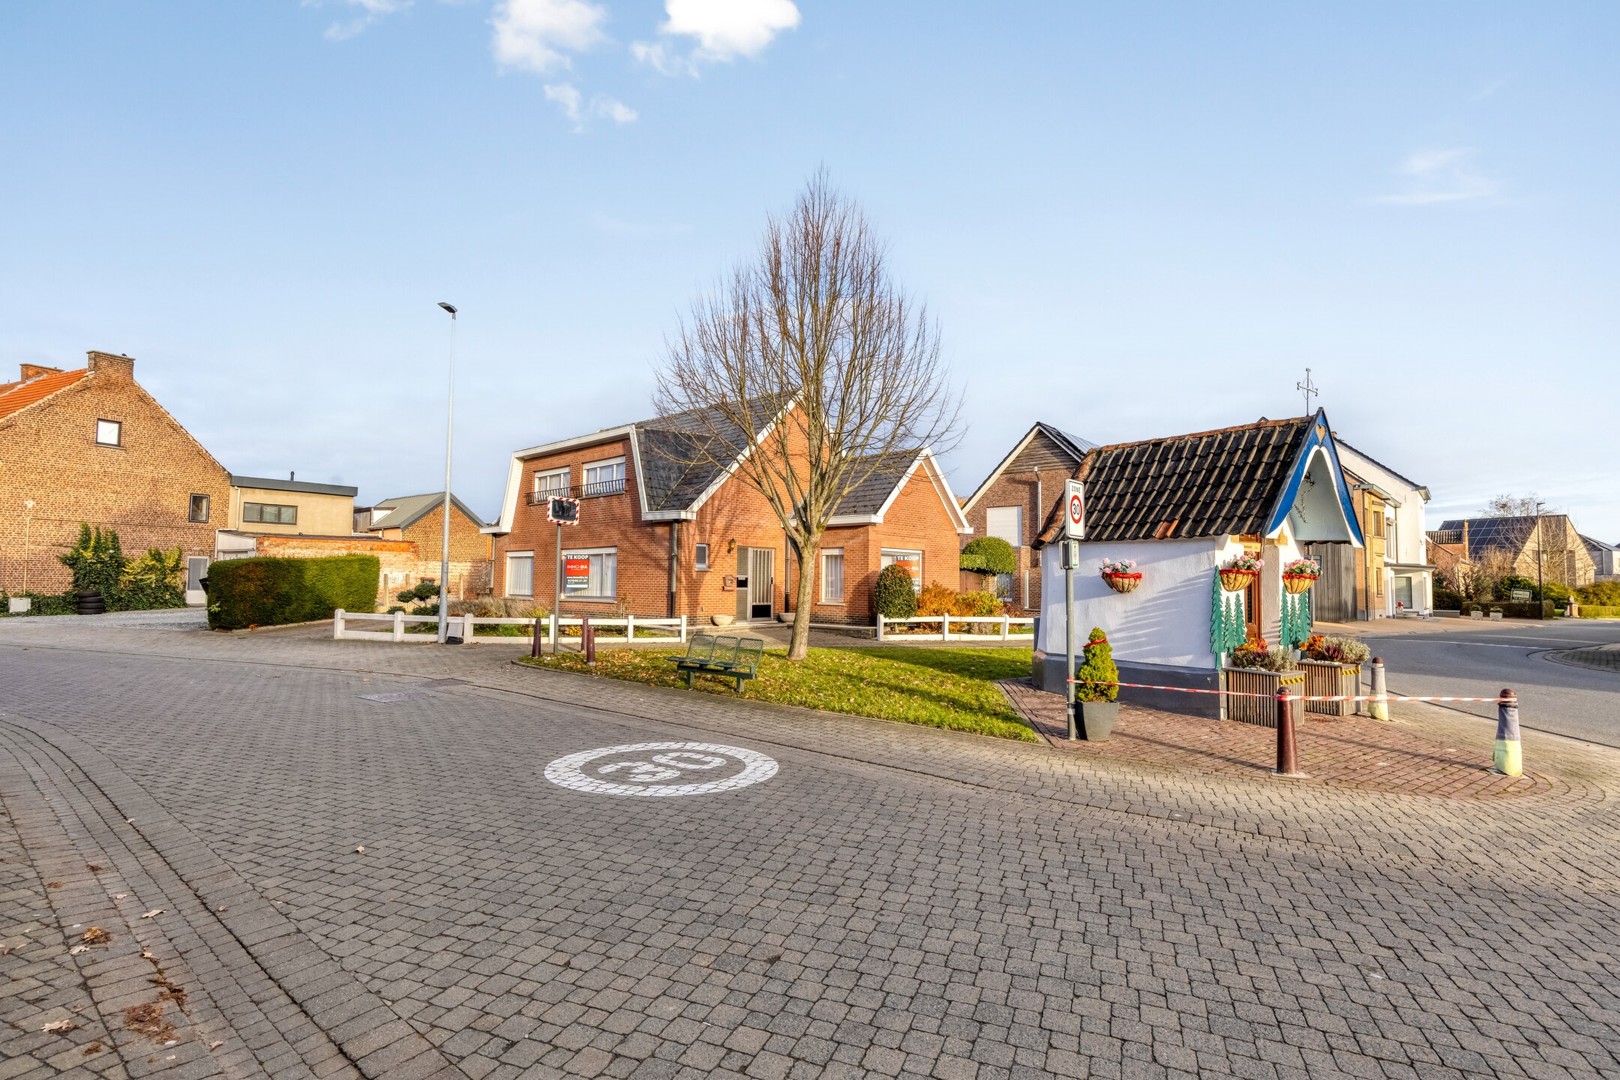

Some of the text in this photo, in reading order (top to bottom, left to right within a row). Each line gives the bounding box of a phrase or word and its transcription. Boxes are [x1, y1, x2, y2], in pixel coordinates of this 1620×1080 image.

[1072, 485, 1080, 494] ZONE
[1072, 503, 1080, 516] 30
[598, 752, 727, 782] 30
